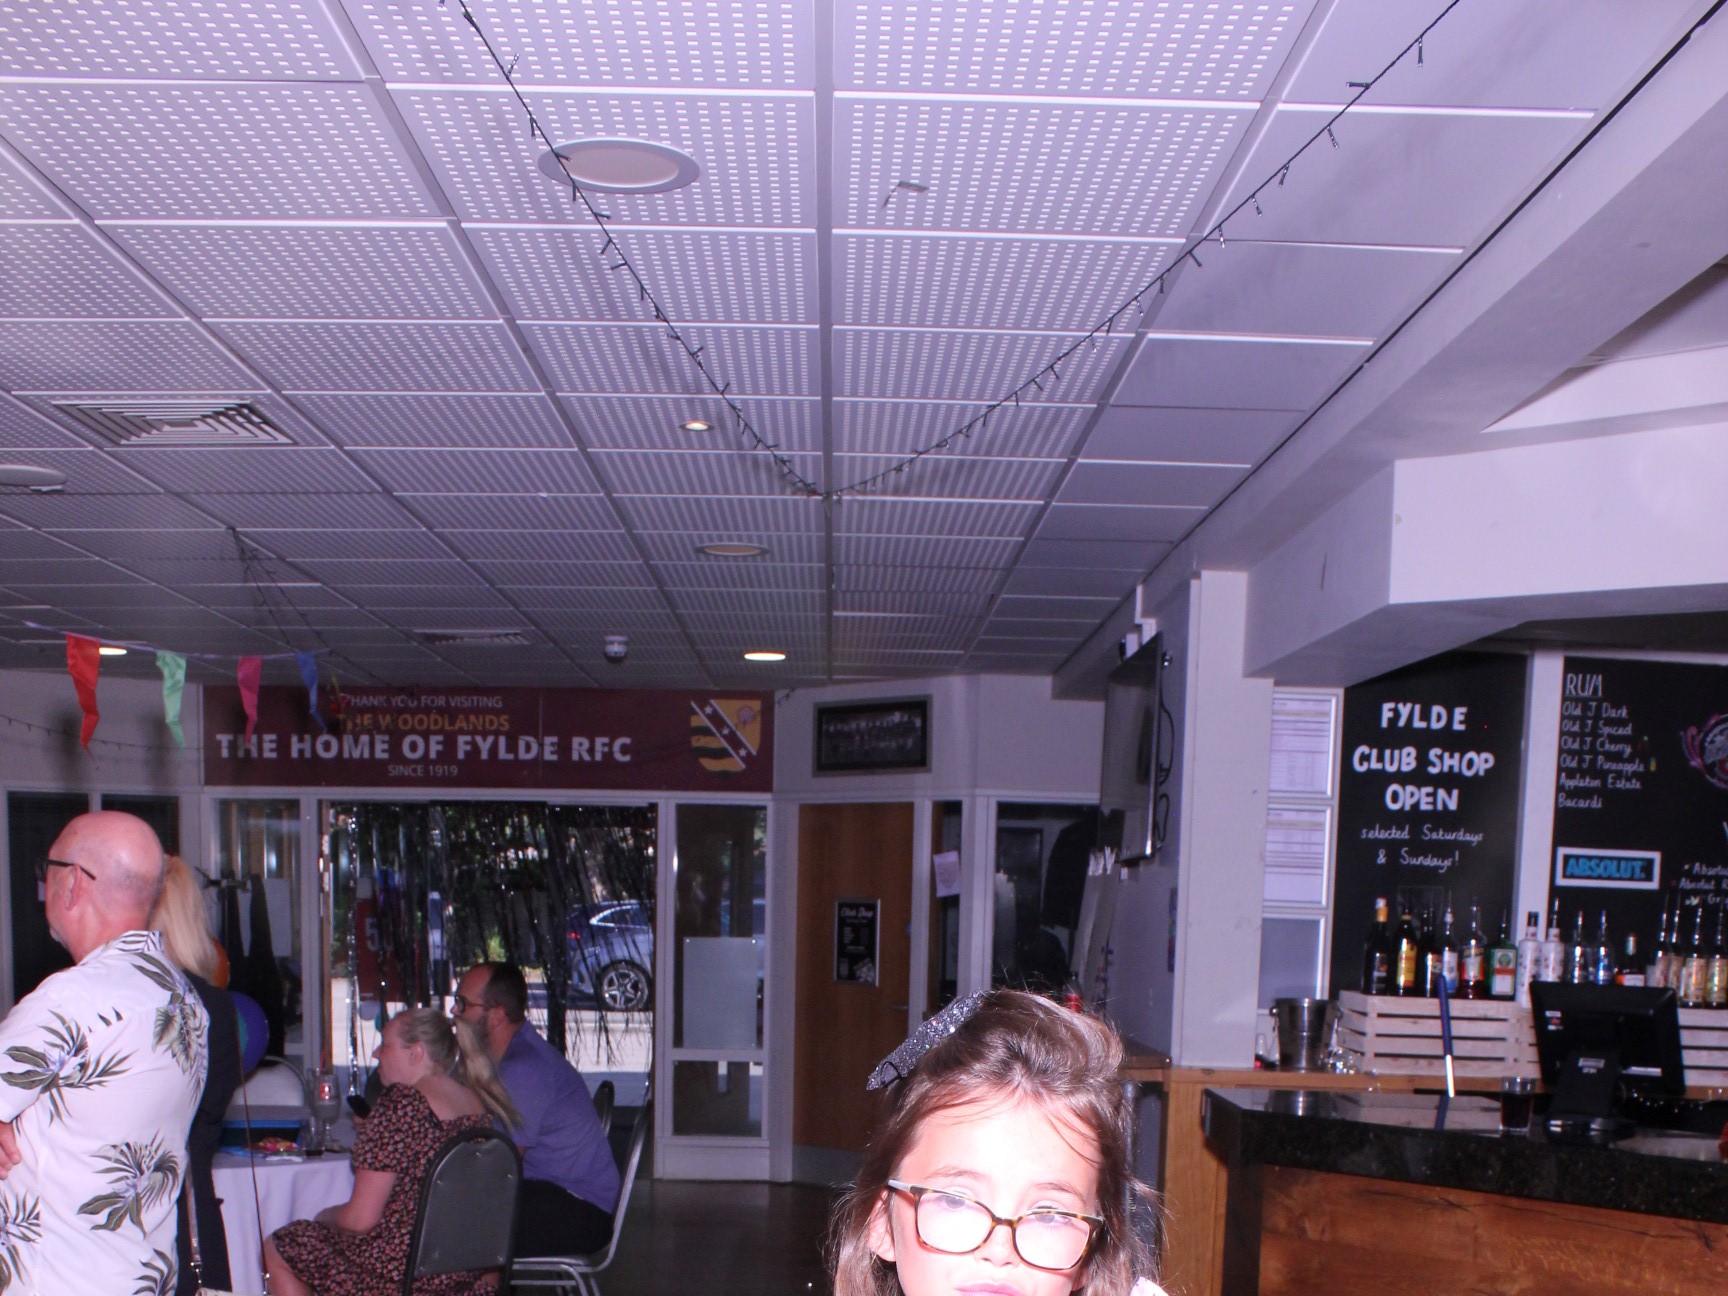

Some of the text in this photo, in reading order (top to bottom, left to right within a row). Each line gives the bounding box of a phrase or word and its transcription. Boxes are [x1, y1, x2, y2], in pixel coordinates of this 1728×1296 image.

[1565, 673, 1603, 696] RUM
[341, 694, 503, 709] HANK YOU FOR VISITING
[1562, 701, 1582, 716] Old
[1602, 702, 1628, 718] Dark
[378, 713, 511, 732] WOODLANDS
[1380, 702, 1468, 730] FYLDE
[1561, 720, 1580, 732] Old
[215, 733, 633, 762] THE HOME OF FYLDE RFC
[1560, 736, 1580, 750] Old
[1596, 738, 1632, 758] Cherry
[388, 764, 459, 777] SINCE 1919
[1352, 745, 1495, 777] CLUB SHOP
[1560, 754, 1578, 768] Old
[1597, 755, 1645, 776] Pineapple
[1559, 772, 1642, 790] Appleton Estate
[1385, 783, 1459, 811] OPEN
[1558, 793, 1602, 808] Bacardi
[1360, 824, 1484, 846] selected Saturdays
[1376, 847, 1460, 873] & Sundays!
[1692, 862, 1728, 876] Absolu
